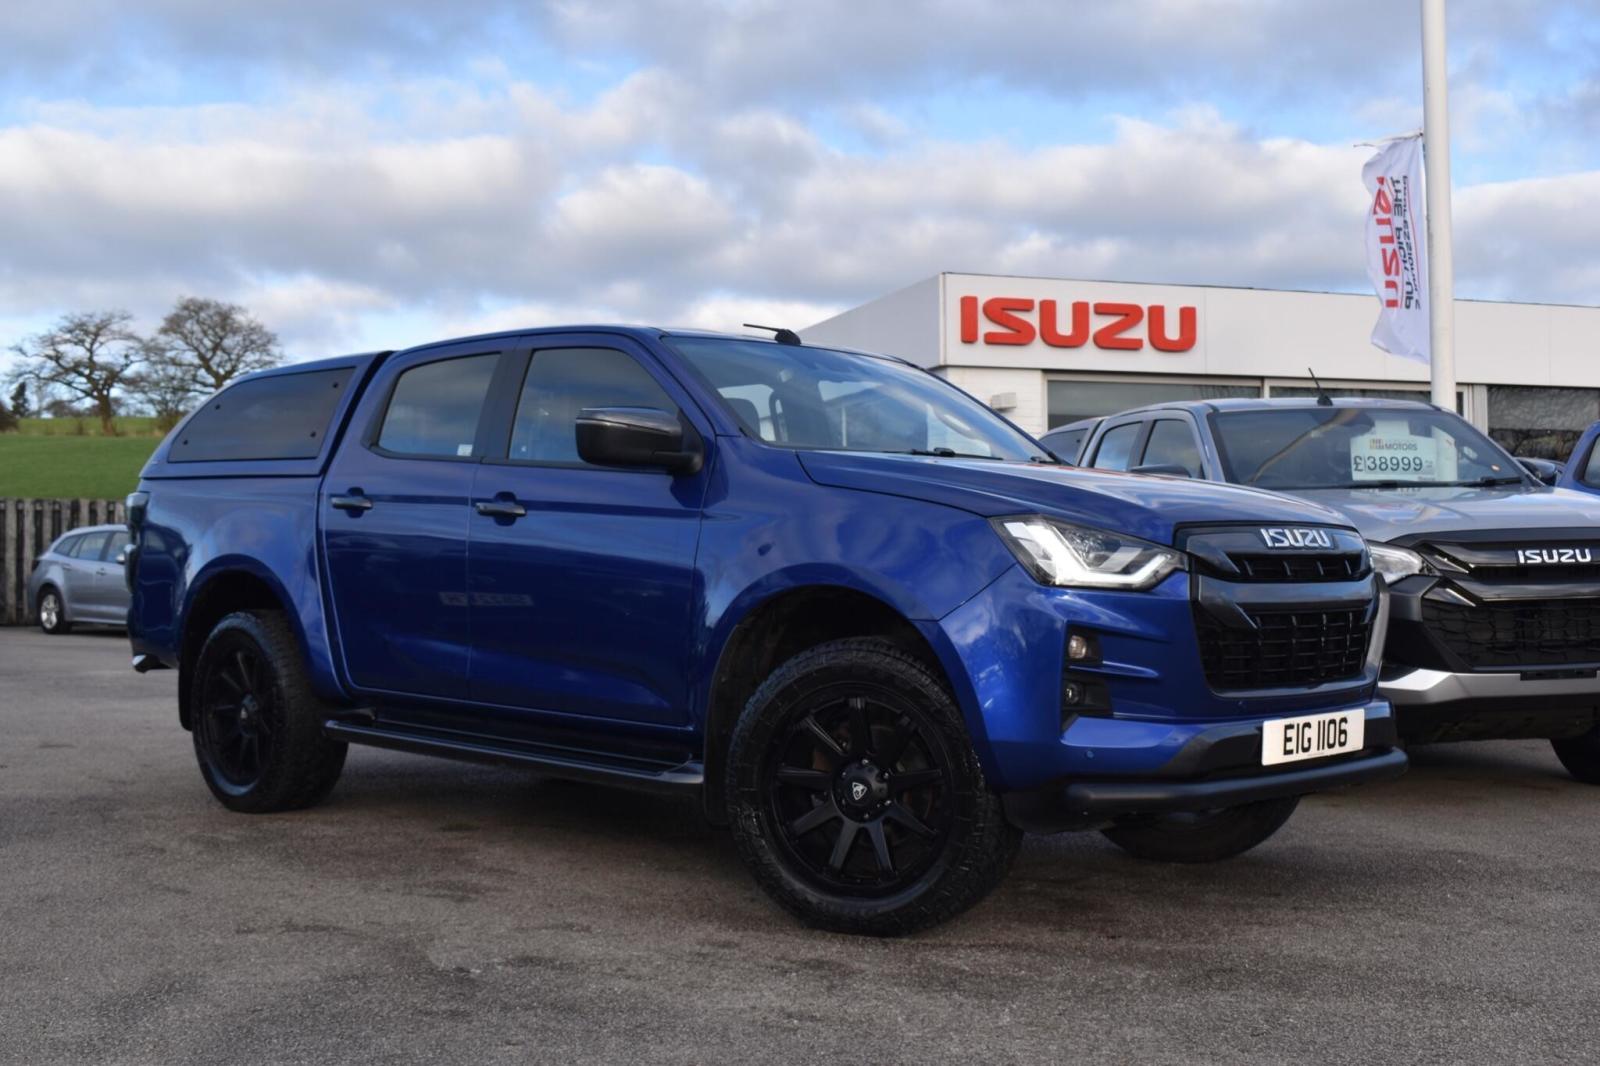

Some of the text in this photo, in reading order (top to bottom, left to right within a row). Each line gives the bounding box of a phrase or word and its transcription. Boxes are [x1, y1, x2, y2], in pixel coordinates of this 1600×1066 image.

[960, 295, 1197, 352] ISUZU
[1353, 455, 1423, 472] £38999
[1260, 528, 1331, 547] ISUZU
[1517, 548, 1592, 564] ISUZU
[1283, 717, 1348, 756] EIG 1106
